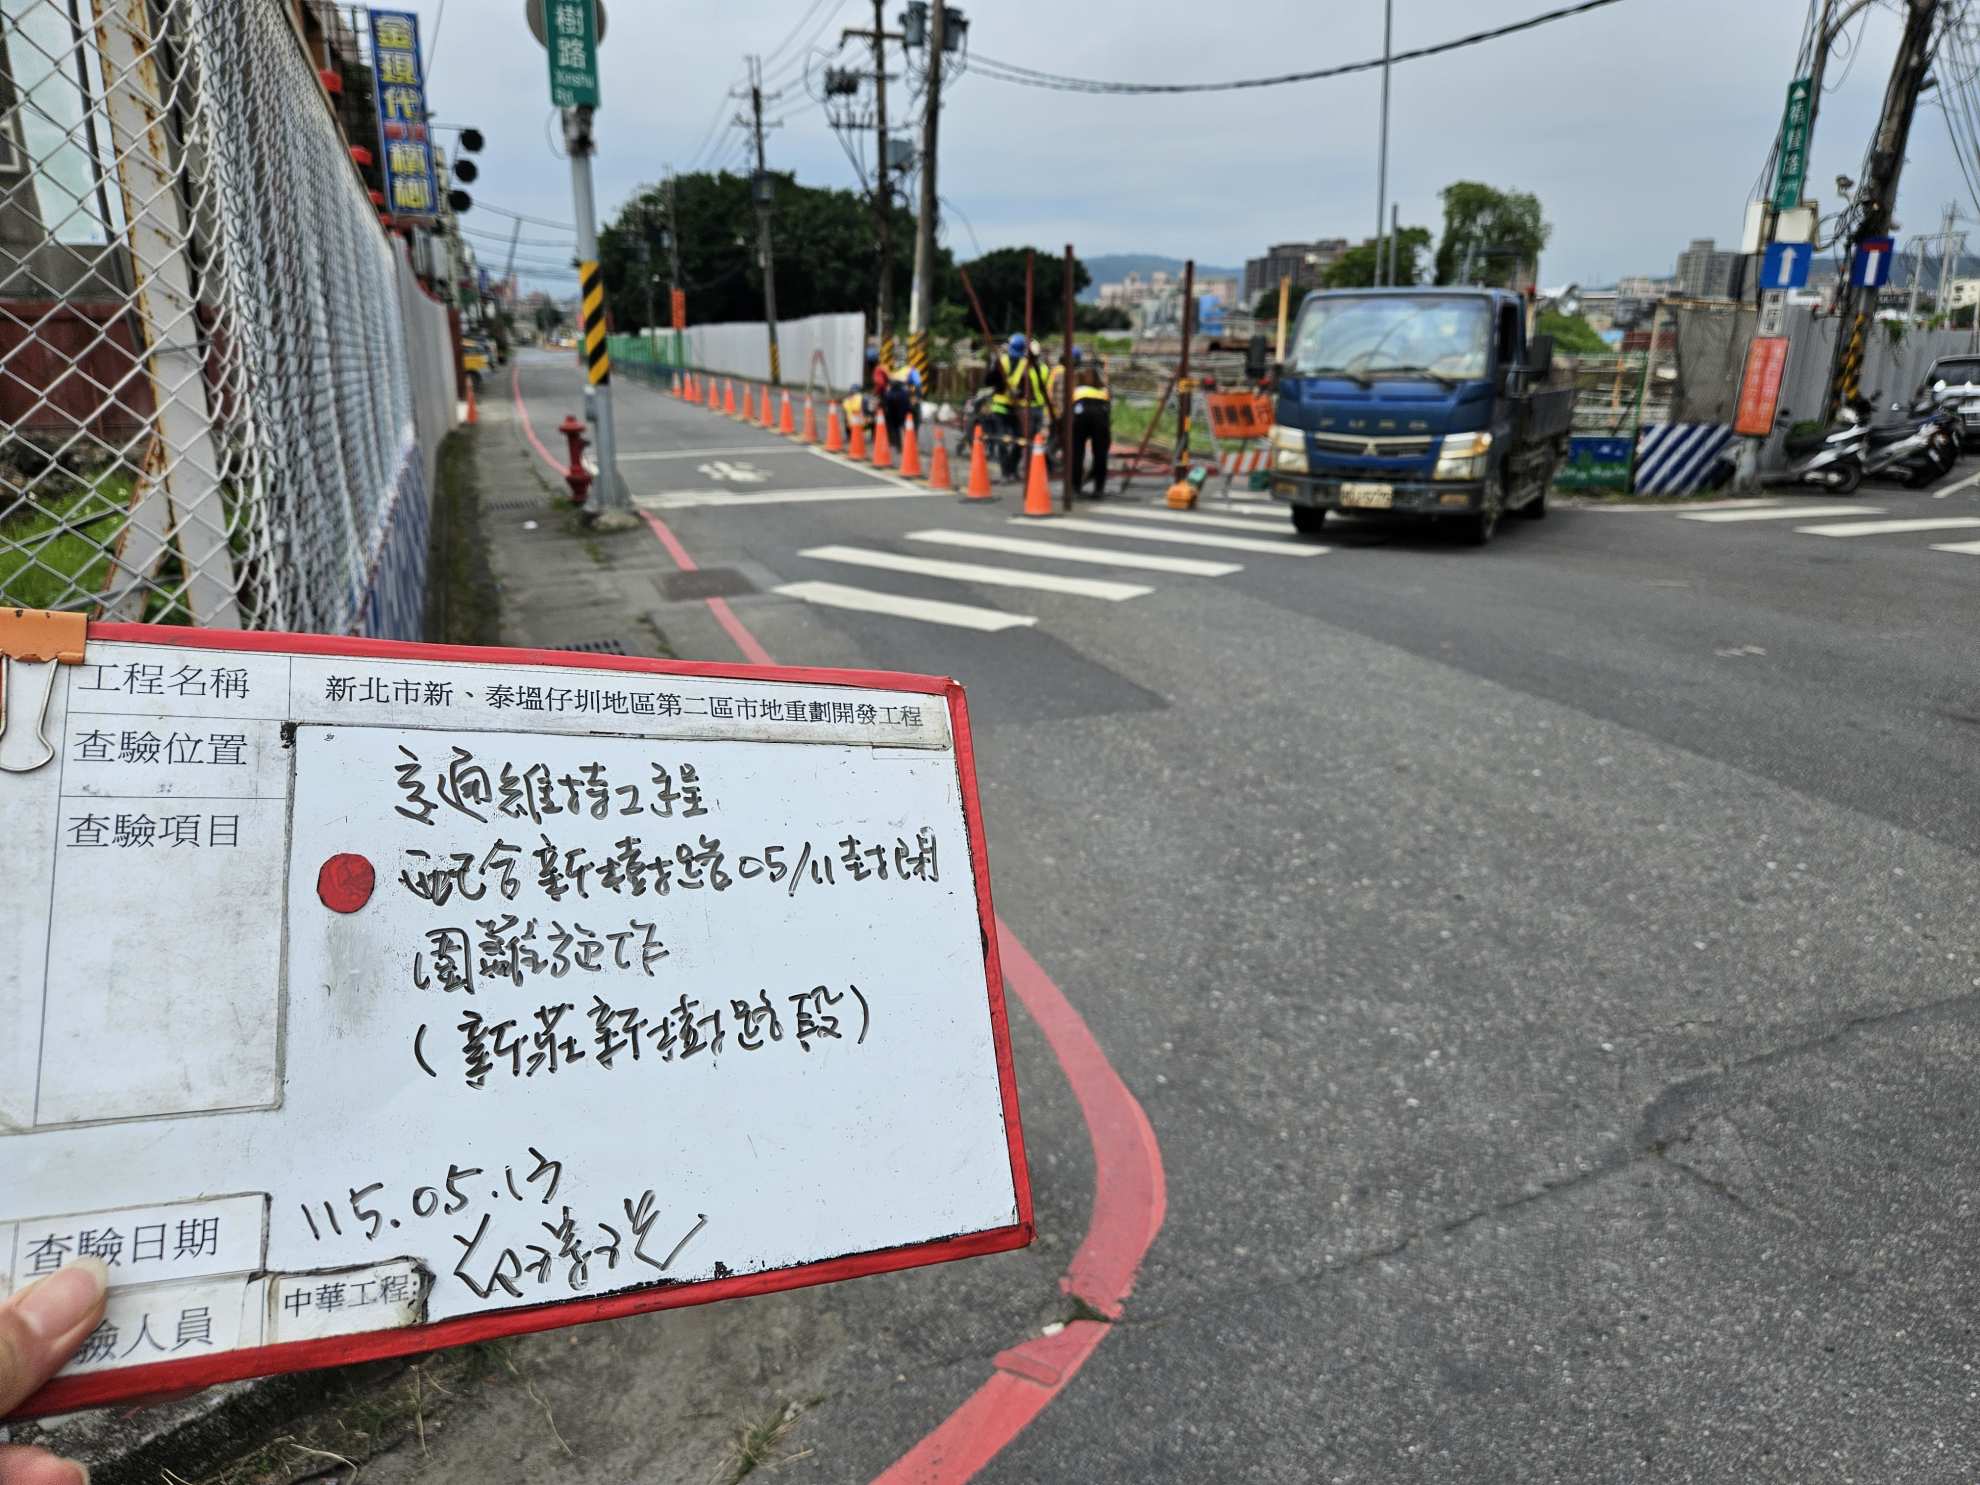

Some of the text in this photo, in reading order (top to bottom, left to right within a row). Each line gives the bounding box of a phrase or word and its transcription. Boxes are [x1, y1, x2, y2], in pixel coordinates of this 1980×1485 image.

[77, 662, 250, 700] 工程名稱
[72, 729, 248, 767] 查驗位置
[394, 745, 710, 826] 交通維持工程
[66, 812, 241, 849] 查驗項目
[25, 1216, 220, 1278] 查驗日期
[73, 1306, 214, 1366] 驗人員
